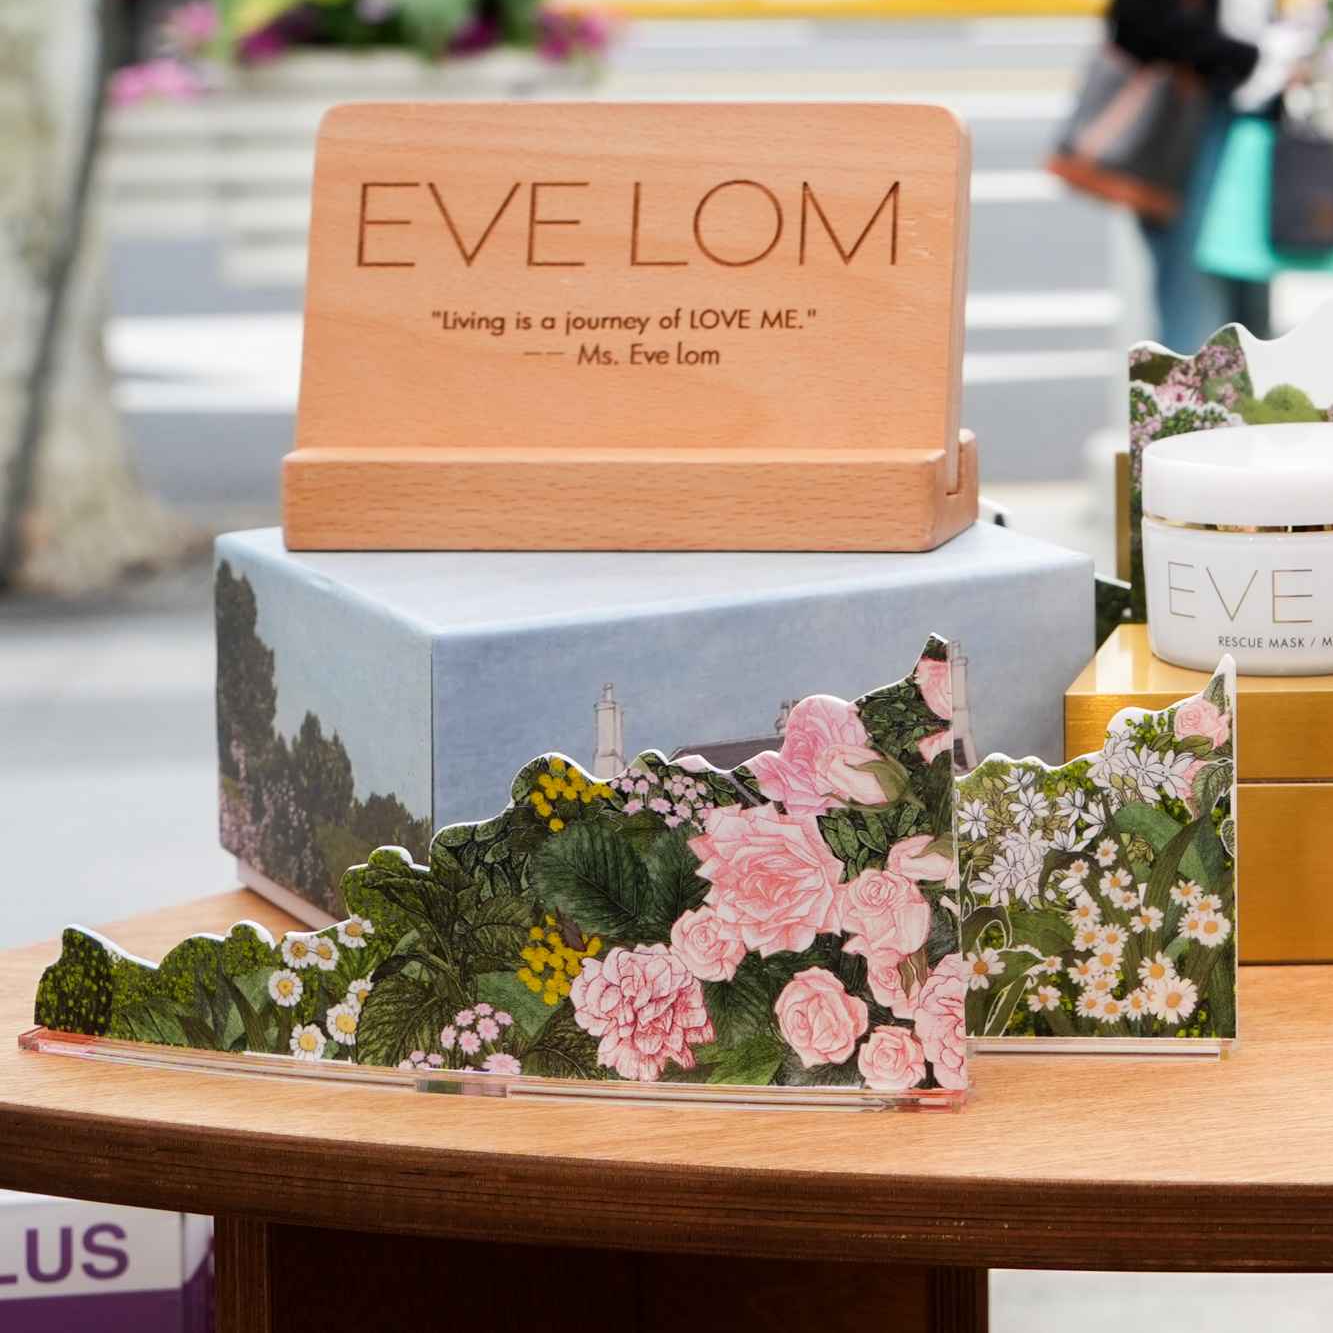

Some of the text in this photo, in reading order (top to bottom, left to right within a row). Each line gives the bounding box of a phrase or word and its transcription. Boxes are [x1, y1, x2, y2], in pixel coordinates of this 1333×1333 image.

[356, 178, 901, 268] EVE LOM
[431, 308, 817, 336] "Living is a journey of LOVE ME."
[577, 343, 619, 366] Ms.
[630, 342, 670, 366] Eve
[1168, 561, 1313, 623] EVE
[1218, 635, 1263, 649] RESCUE
[1268, 637, 1306, 648] MASK
